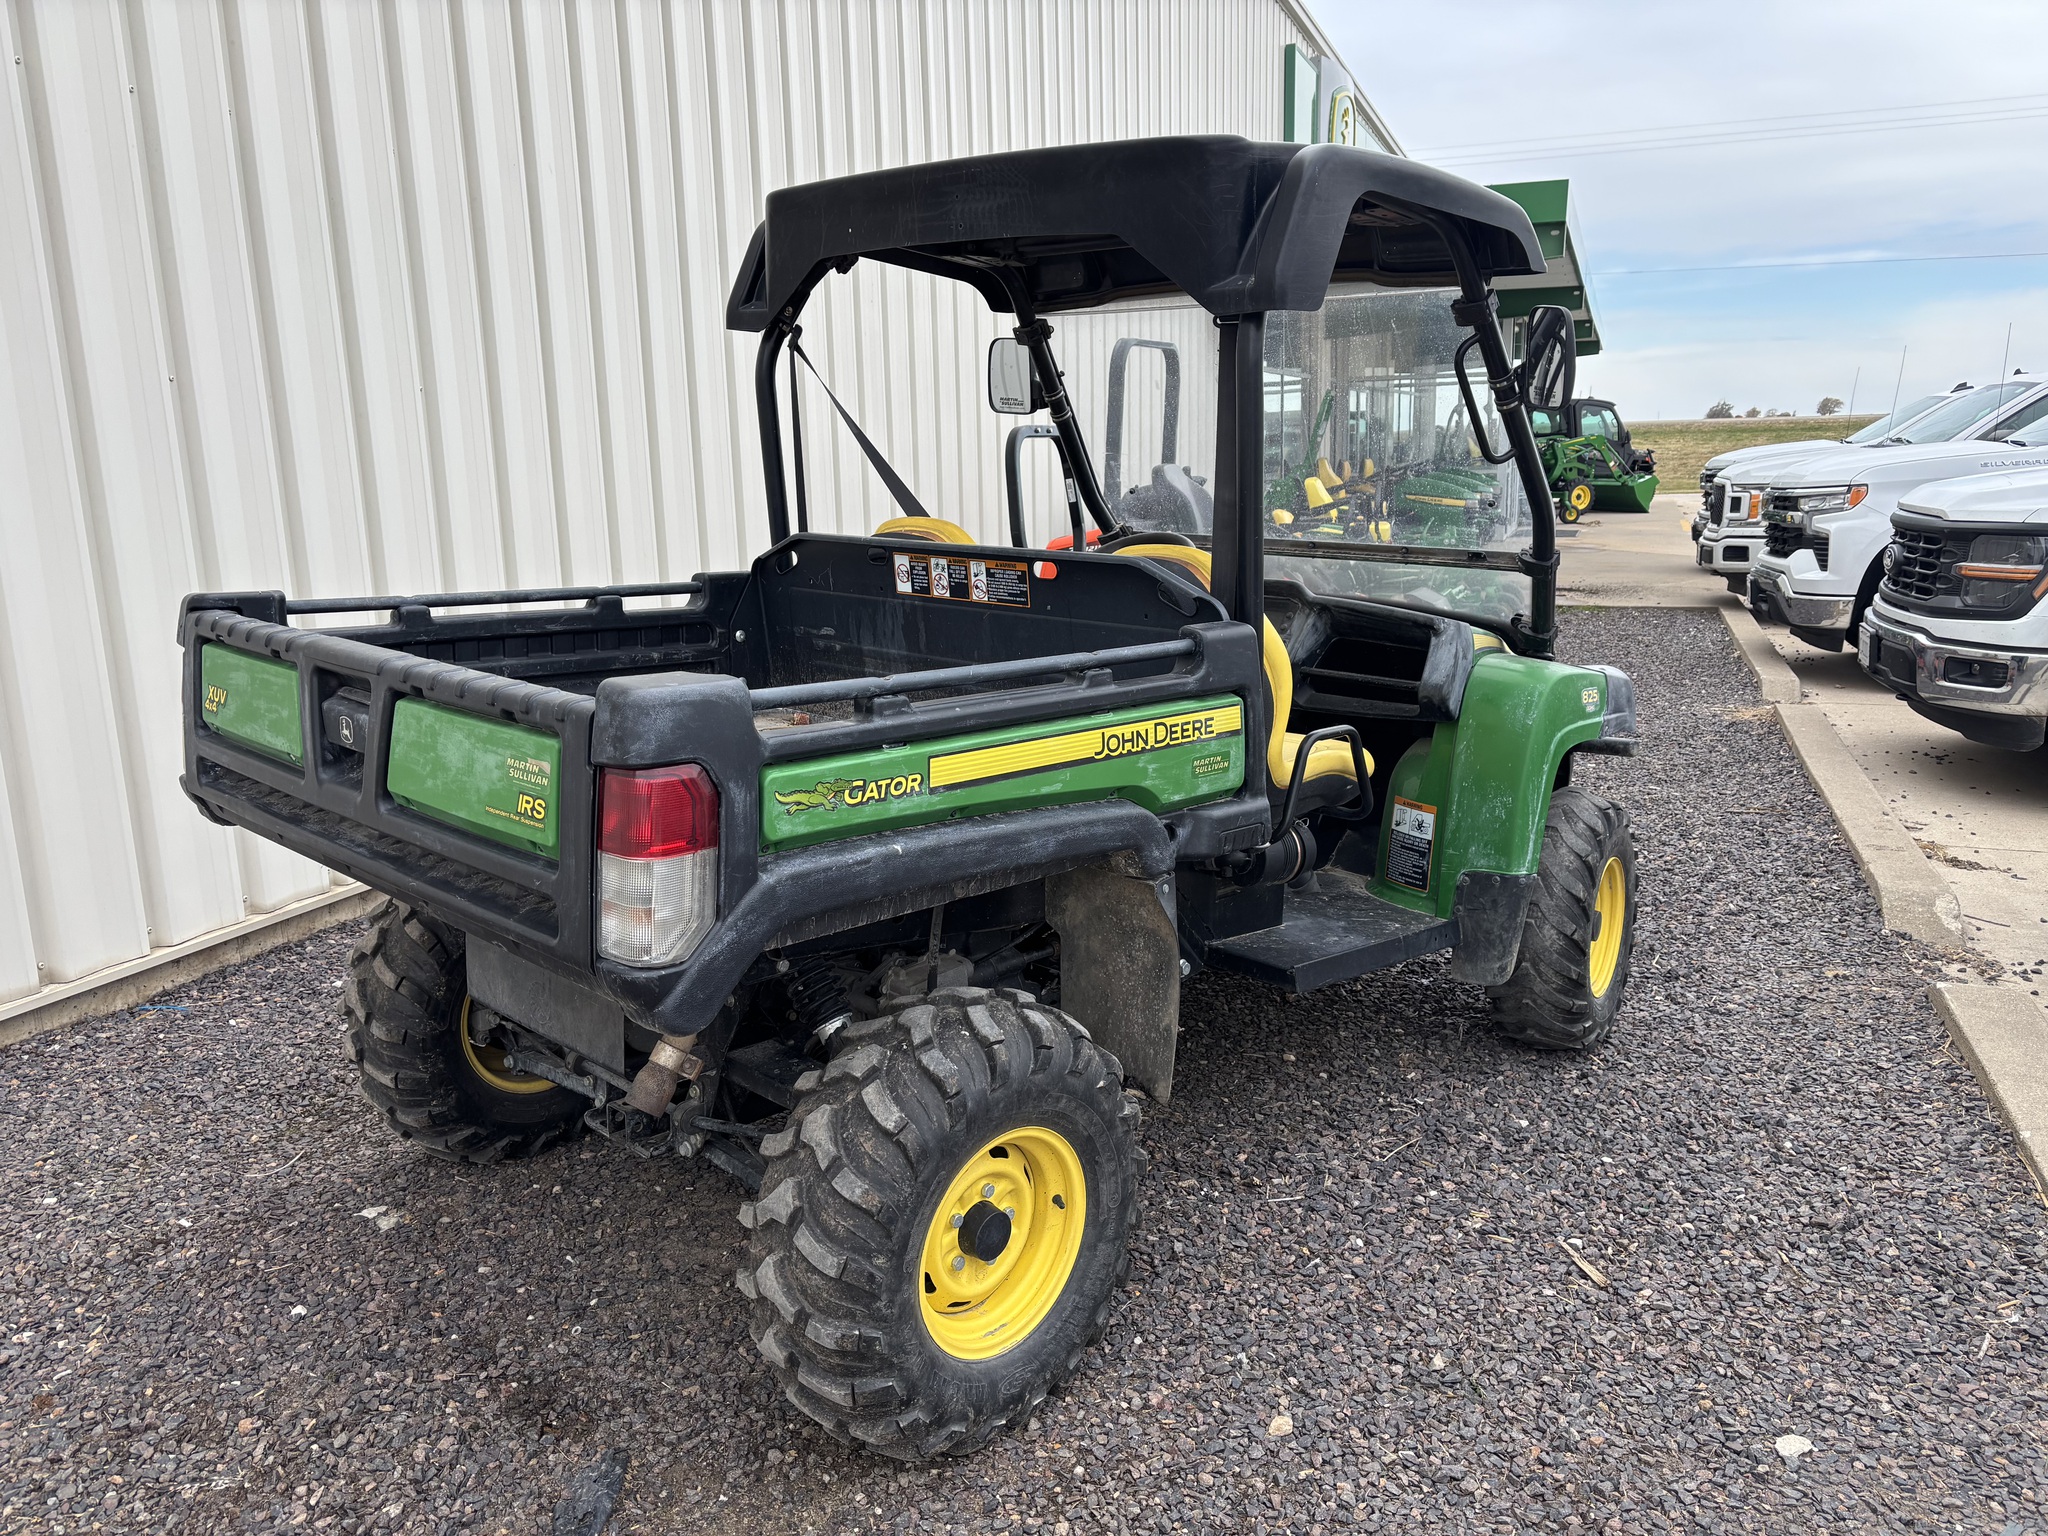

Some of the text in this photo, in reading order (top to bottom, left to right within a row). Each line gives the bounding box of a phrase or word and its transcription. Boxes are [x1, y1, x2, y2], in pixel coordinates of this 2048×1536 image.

[208, 685, 227, 704] XUV
[1583, 689, 1598, 703] 825
[204, 699, 217, 713] 4x4
[1094, 716, 1215, 757] JOHN DEERE
[506, 757, 540, 773] MARTIN
[1193, 755, 1222, 767] MARTIN
[1194, 761, 1229, 774] SULLIVAN
[509, 768, 549, 786] SULLIVAN
[843, 773, 922, 806] GATOR
[517, 793, 546, 820] IRS
[485, 806, 544, 828] Independent Rear Suspension
